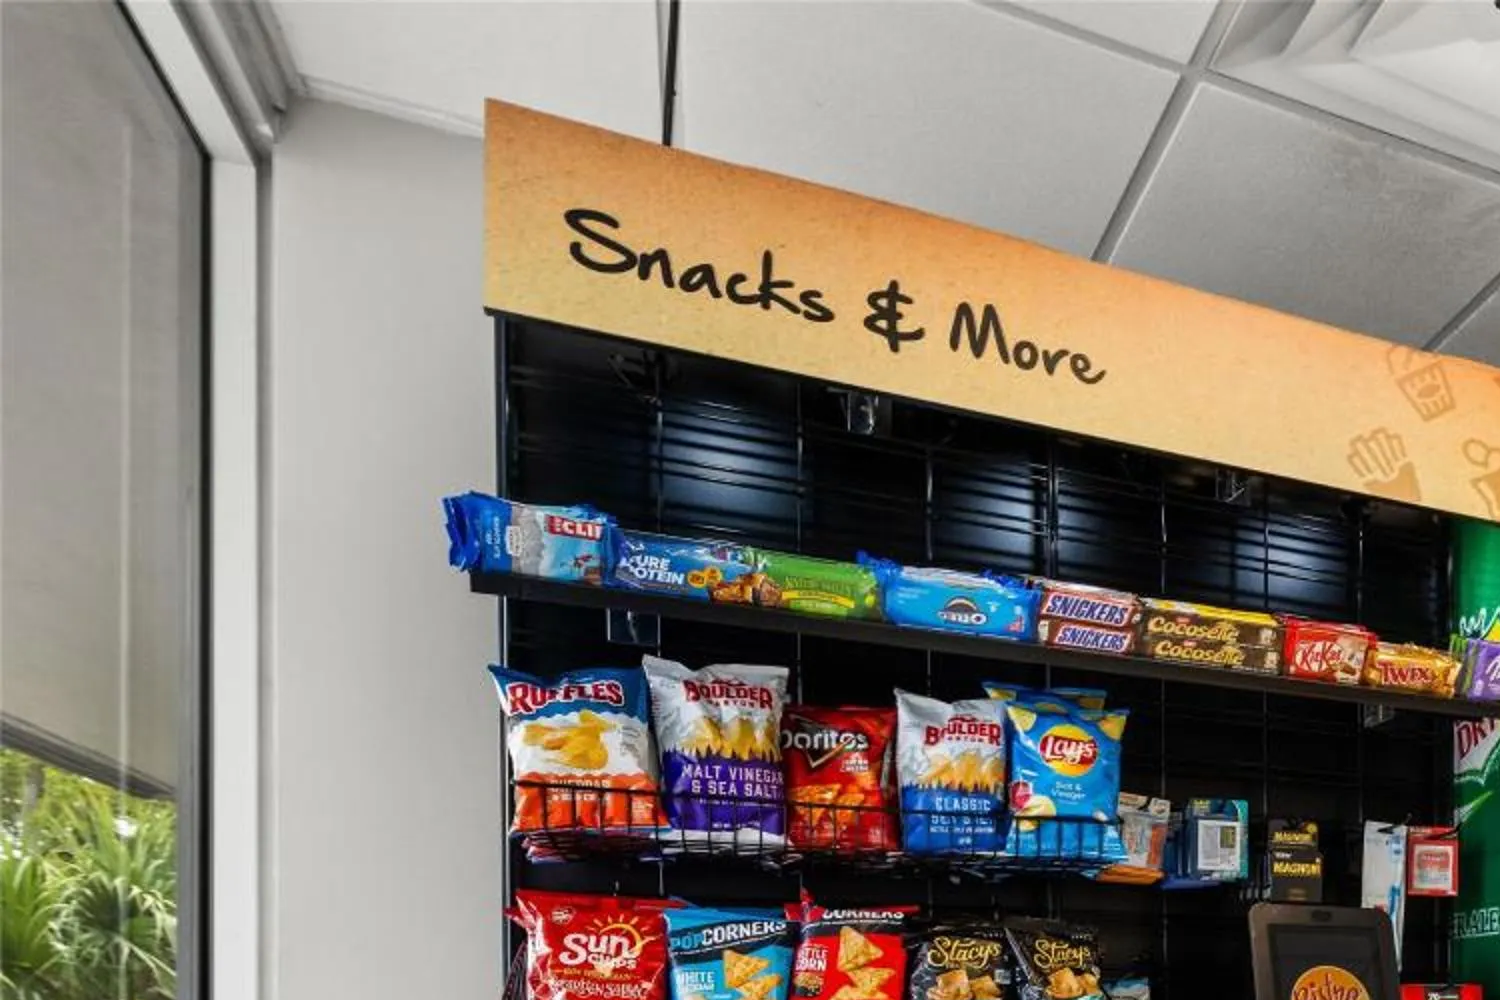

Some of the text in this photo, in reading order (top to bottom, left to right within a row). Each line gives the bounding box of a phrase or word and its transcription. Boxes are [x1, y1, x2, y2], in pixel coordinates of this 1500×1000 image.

[563, 208, 1106, 386] Snacks & More
[1049, 595, 1129, 625] SNICKERS
[1056, 627, 1127, 650] SNICKERS
[683, 679, 774, 710] BOULDER
[924, 720, 1002, 747] BOULDER
[680, 764, 722, 780] MALT
[707, 781, 737, 796] SEA
[744, 783, 777, 798] SALT
[935, 796, 991, 812] CLASSIC
[559, 932, 641, 966] Sun
